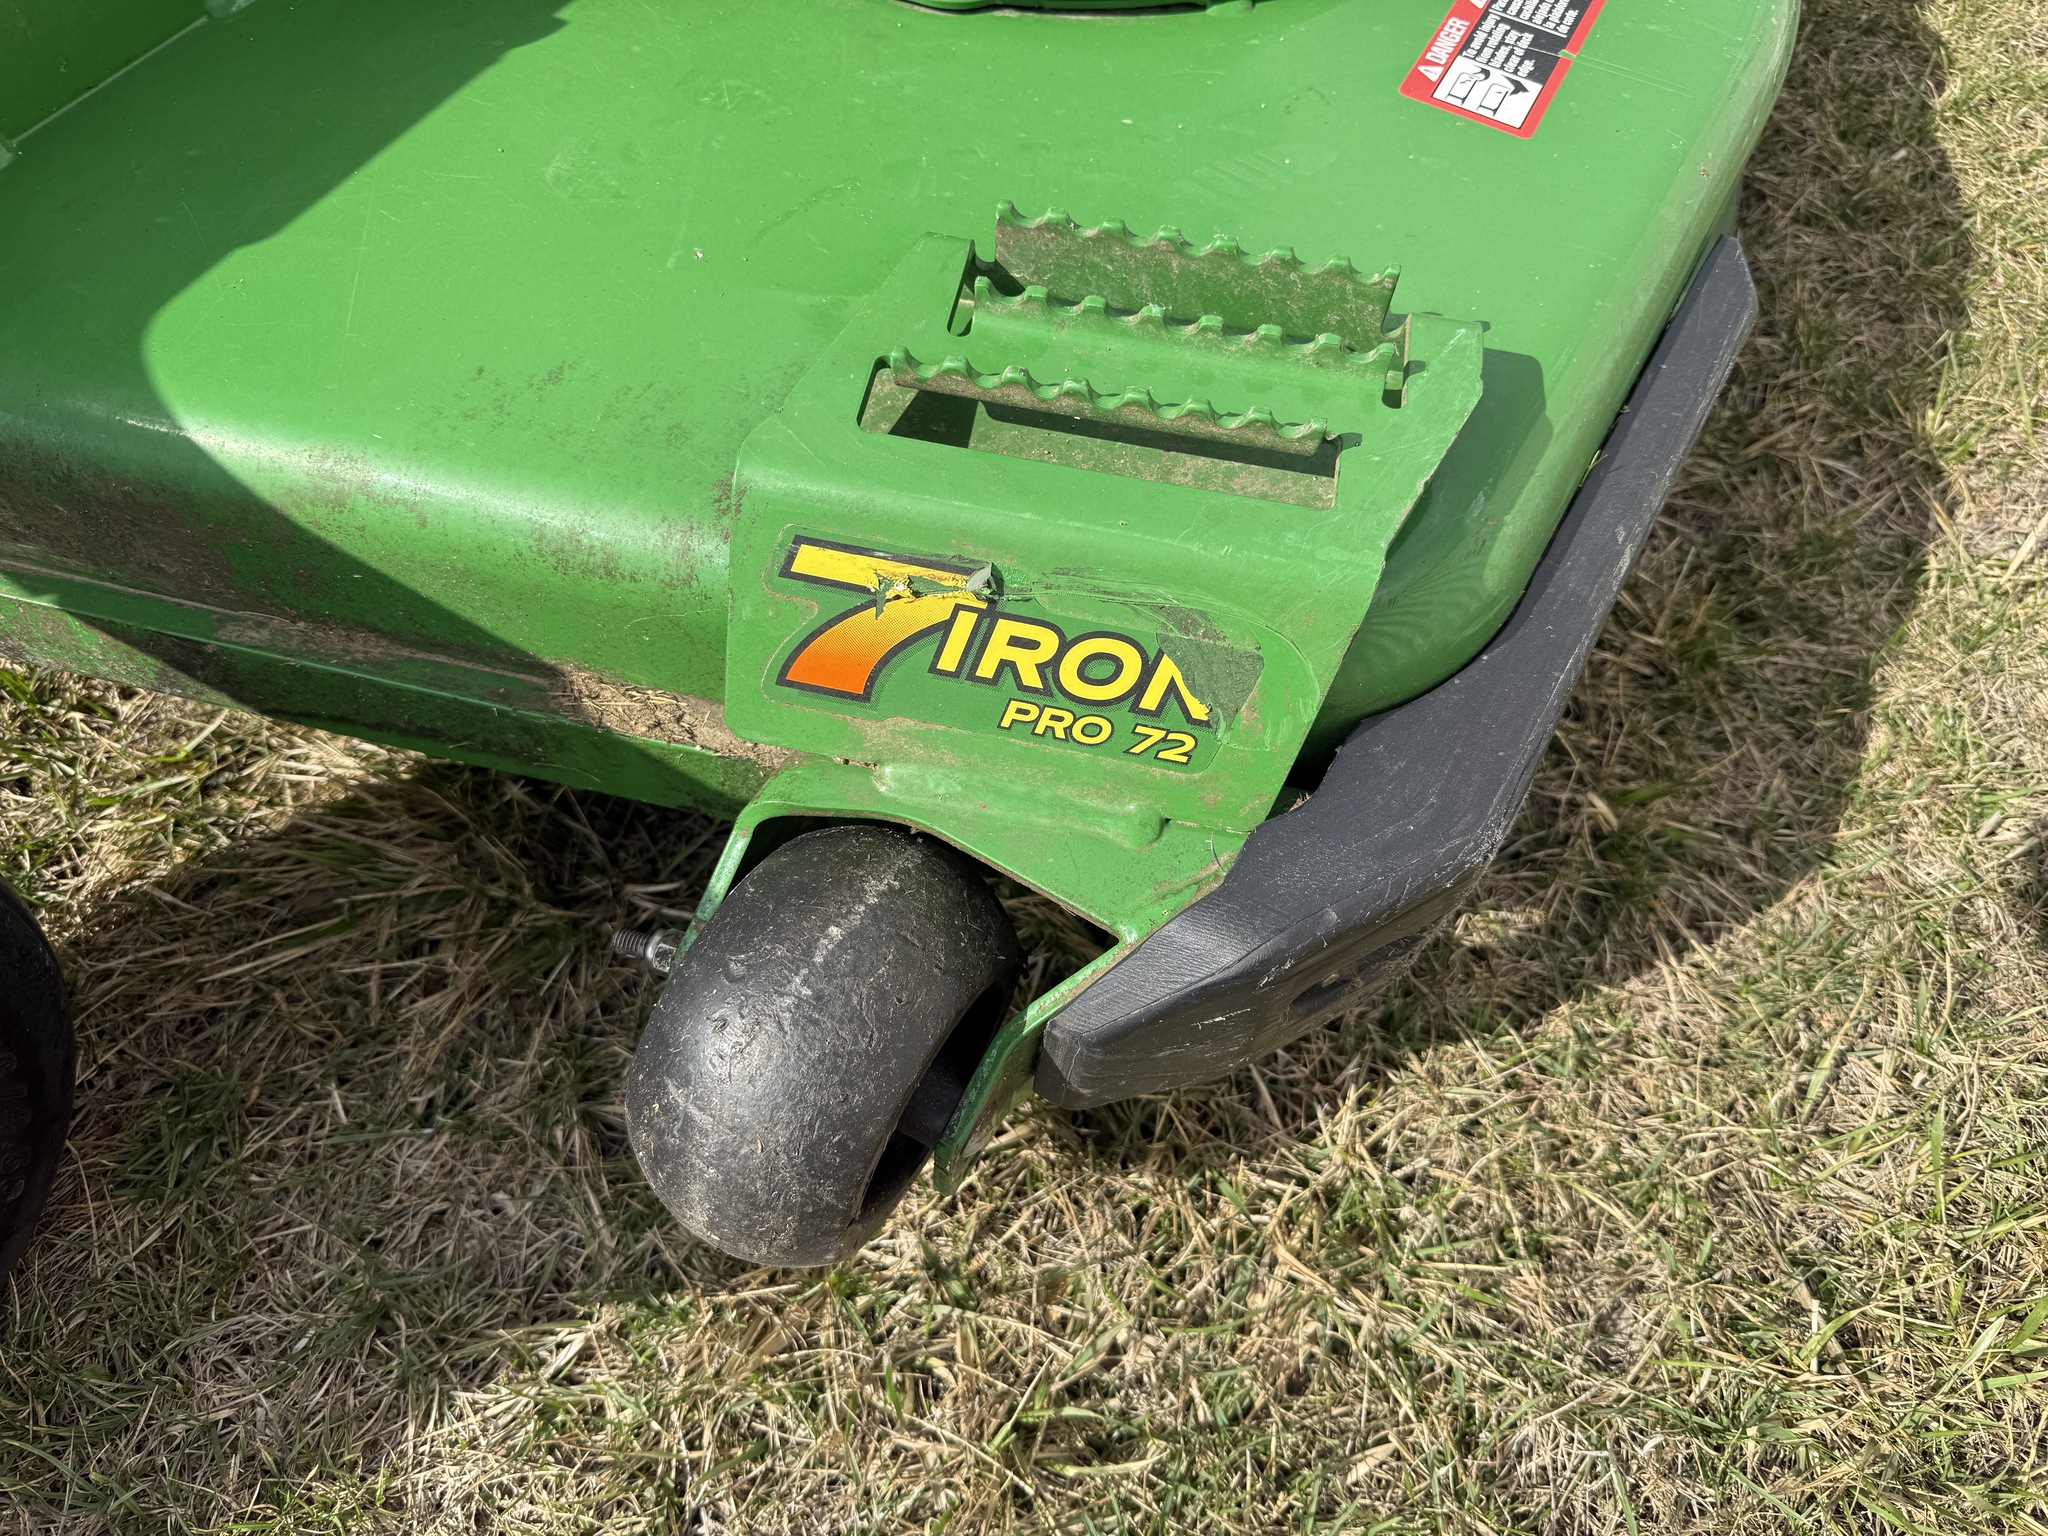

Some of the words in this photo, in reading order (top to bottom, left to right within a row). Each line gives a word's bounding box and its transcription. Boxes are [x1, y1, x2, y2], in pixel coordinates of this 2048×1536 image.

[1478, 14, 1500, 32] injury
[1425, 17, 1470, 65] DANGER
[1470, 31, 1487, 49] avoid
[1476, 47, 1493, 63] from
[1487, 23, 1510, 48] rotating
[1488, 46, 1512, 67] blades,
[1505, 29, 1521, 45] stay
[1515, 33, 1534, 48] deck
[1462, 48, 1477, 58] To
[1514, 47, 1525, 56] of
[1504, 55, 1520, 72] clear
[1517, 60, 1535, 77] edge.
[776, 535, 999, 703] 7
[998, 698, 1114, 746] PRO
[1124, 724, 1198, 766] 72
